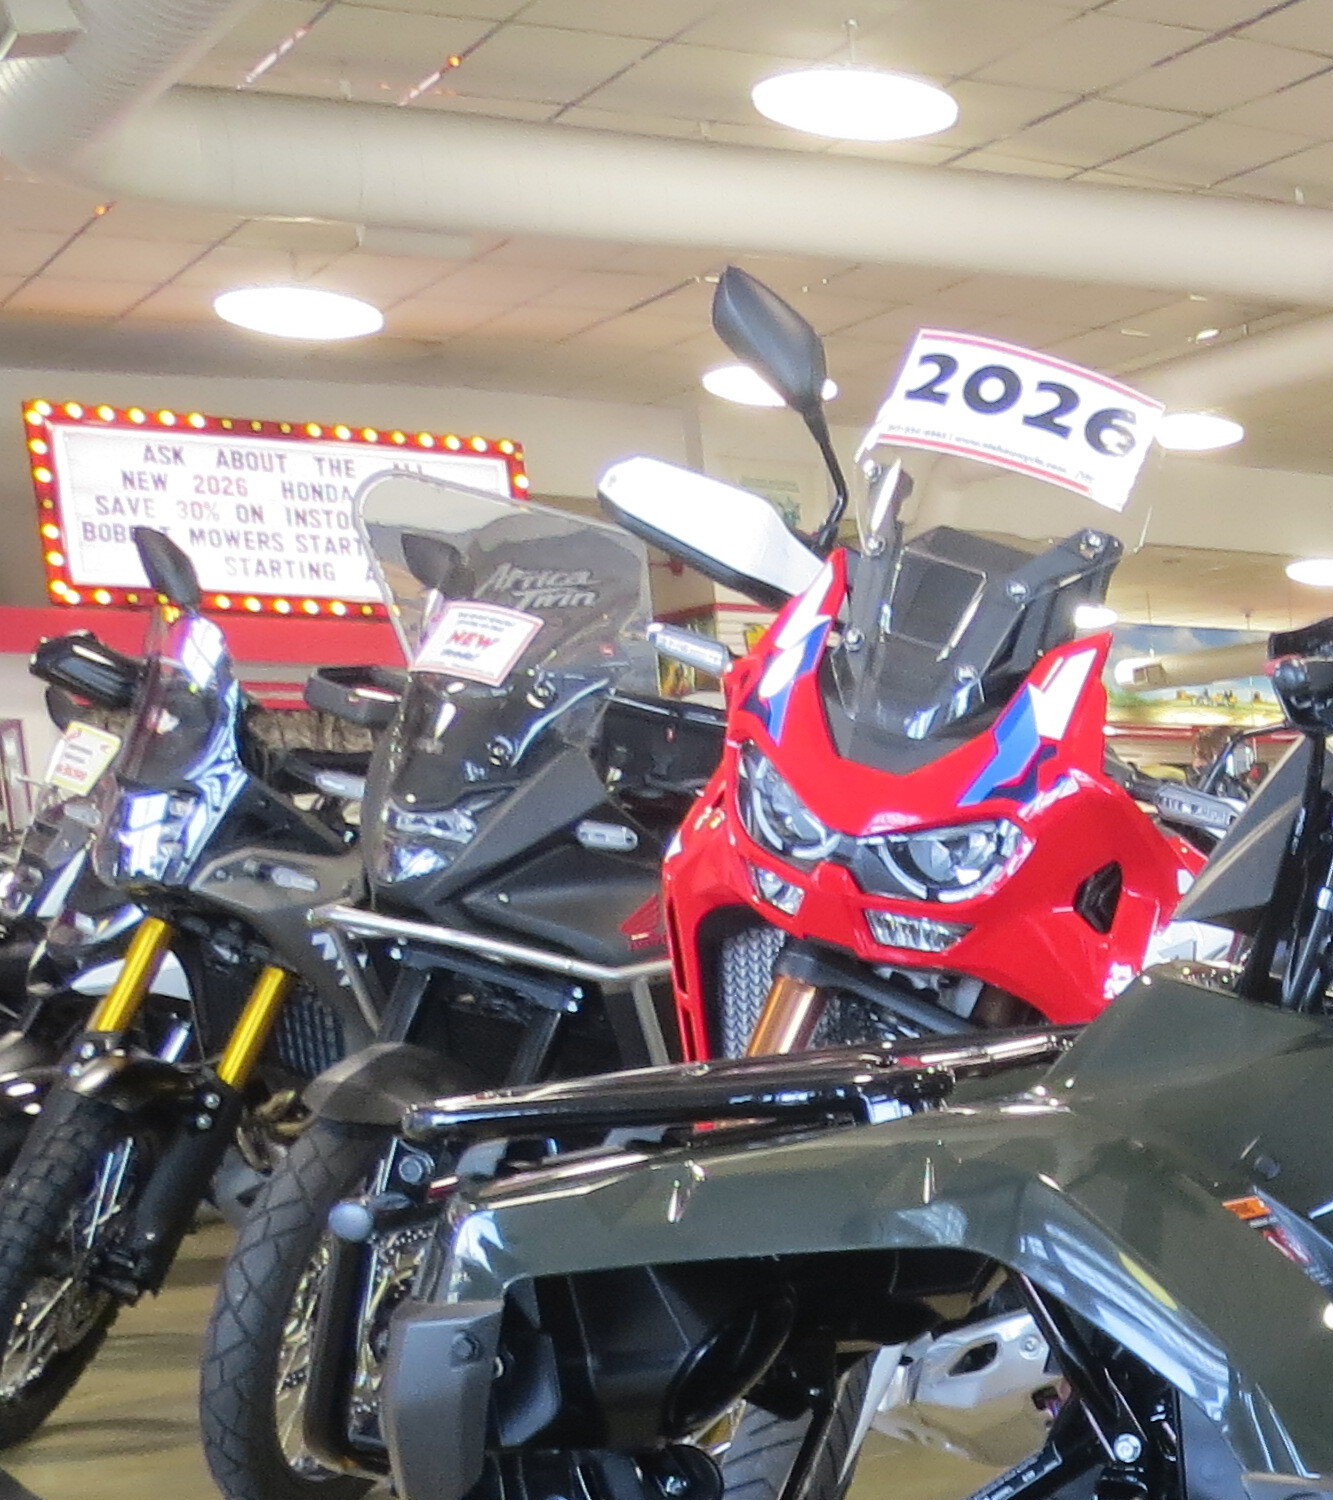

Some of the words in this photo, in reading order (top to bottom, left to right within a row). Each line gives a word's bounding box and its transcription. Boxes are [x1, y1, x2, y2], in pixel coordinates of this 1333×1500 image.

[904, 352, 1137, 457] 2026
[143, 444, 185, 466] ASK
[216, 449, 288, 473] ABOUT
[313, 455, 356, 478] THE
[121, 469, 168, 492] NEW
[193, 474, 249, 498] 2026
[94, 494, 156, 519] SAVE
[175, 499, 221, 523] 30%
[235, 503, 265, 525] ON
[285, 506, 350, 530] INSTO
[189, 527, 285, 553] MOWERS
[224, 556, 336, 582] STARTING
